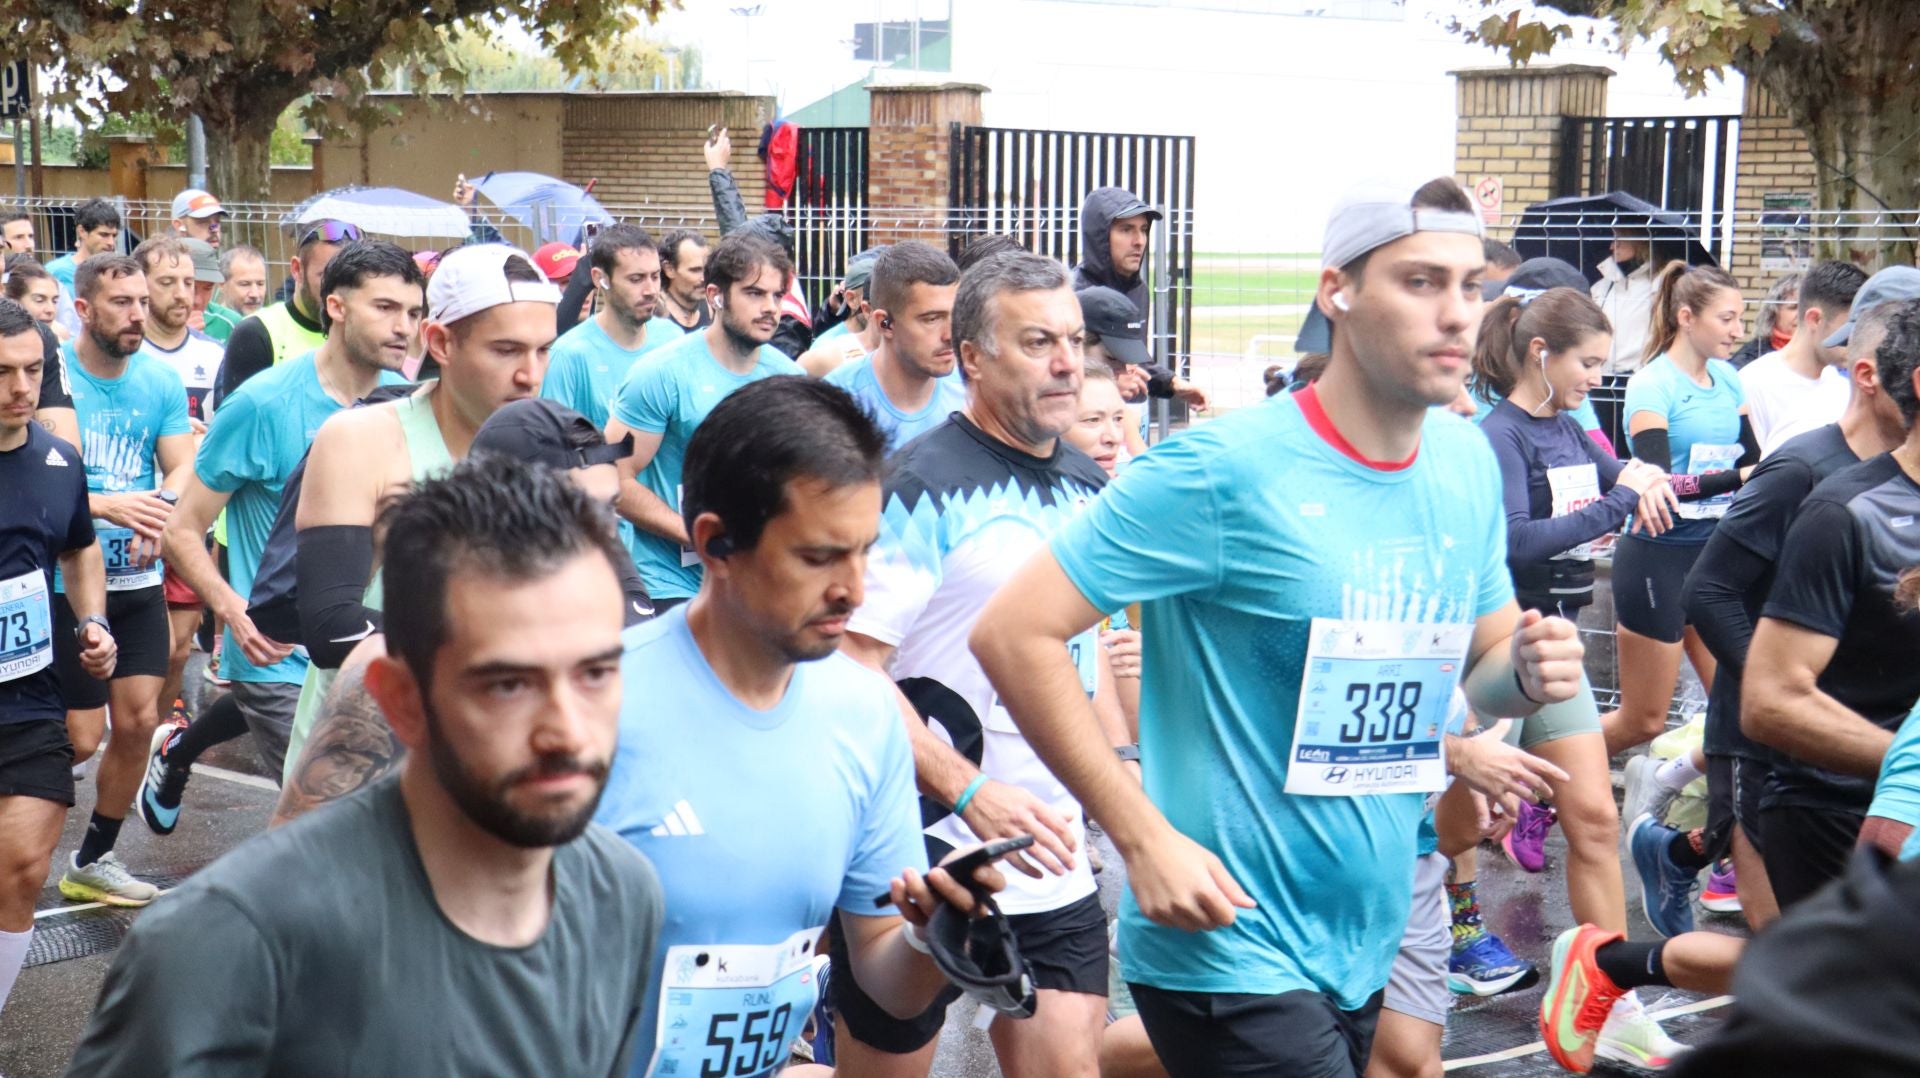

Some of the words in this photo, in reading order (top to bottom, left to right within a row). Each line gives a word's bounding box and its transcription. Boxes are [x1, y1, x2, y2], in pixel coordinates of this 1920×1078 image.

[2, 60, 18, 114] P
[1339, 681, 1422, 743] 338
[1354, 764, 1418, 782] HYUNDAI
[718, 957, 727, 973] k
[700, 1002, 792, 1078] 559
